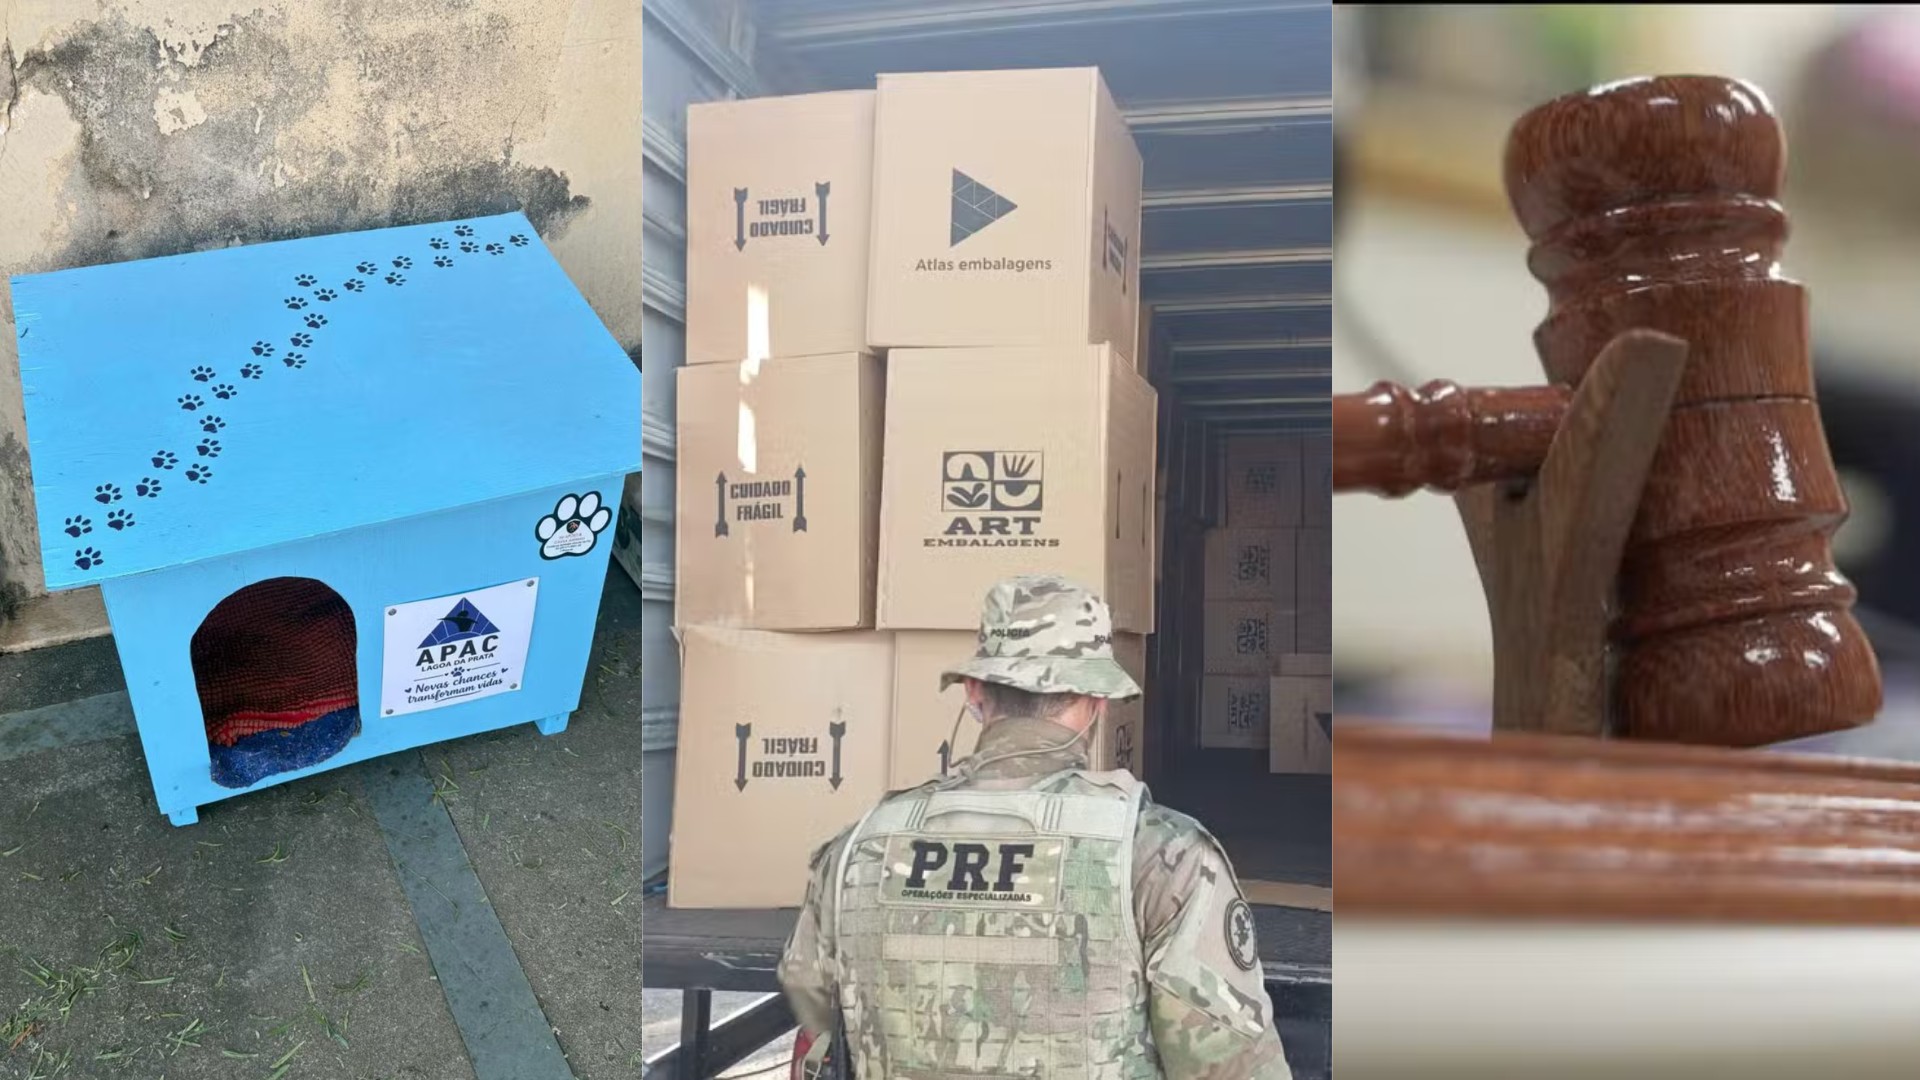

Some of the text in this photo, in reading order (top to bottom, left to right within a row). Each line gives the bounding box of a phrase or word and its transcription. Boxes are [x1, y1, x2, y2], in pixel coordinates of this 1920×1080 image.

[757, 198, 806, 217] FRÁGIL
[750, 219, 813, 237] CUIDADO
[915, 257, 1052, 272] Atlas embalagens
[731, 480, 791, 499] CUIDADO
[737, 501, 783, 521] FRÁGIL
[943, 516, 1041, 535] ART
[923, 538, 1060, 547] EMBALAGENS
[415, 634, 499, 667] APAC
[421, 652, 494, 672] LAGOA DA PRATA
[415, 670, 497, 693] Novas chances
[407, 679, 503, 704] transformam vidas
[761, 737, 818, 758] FRÁGIL
[752, 760, 825, 778] CUIDADO
[905, 841, 1035, 892] PRF
[901, 889, 1032, 902] OPERAÇÕES ESPECIALIZADAS
